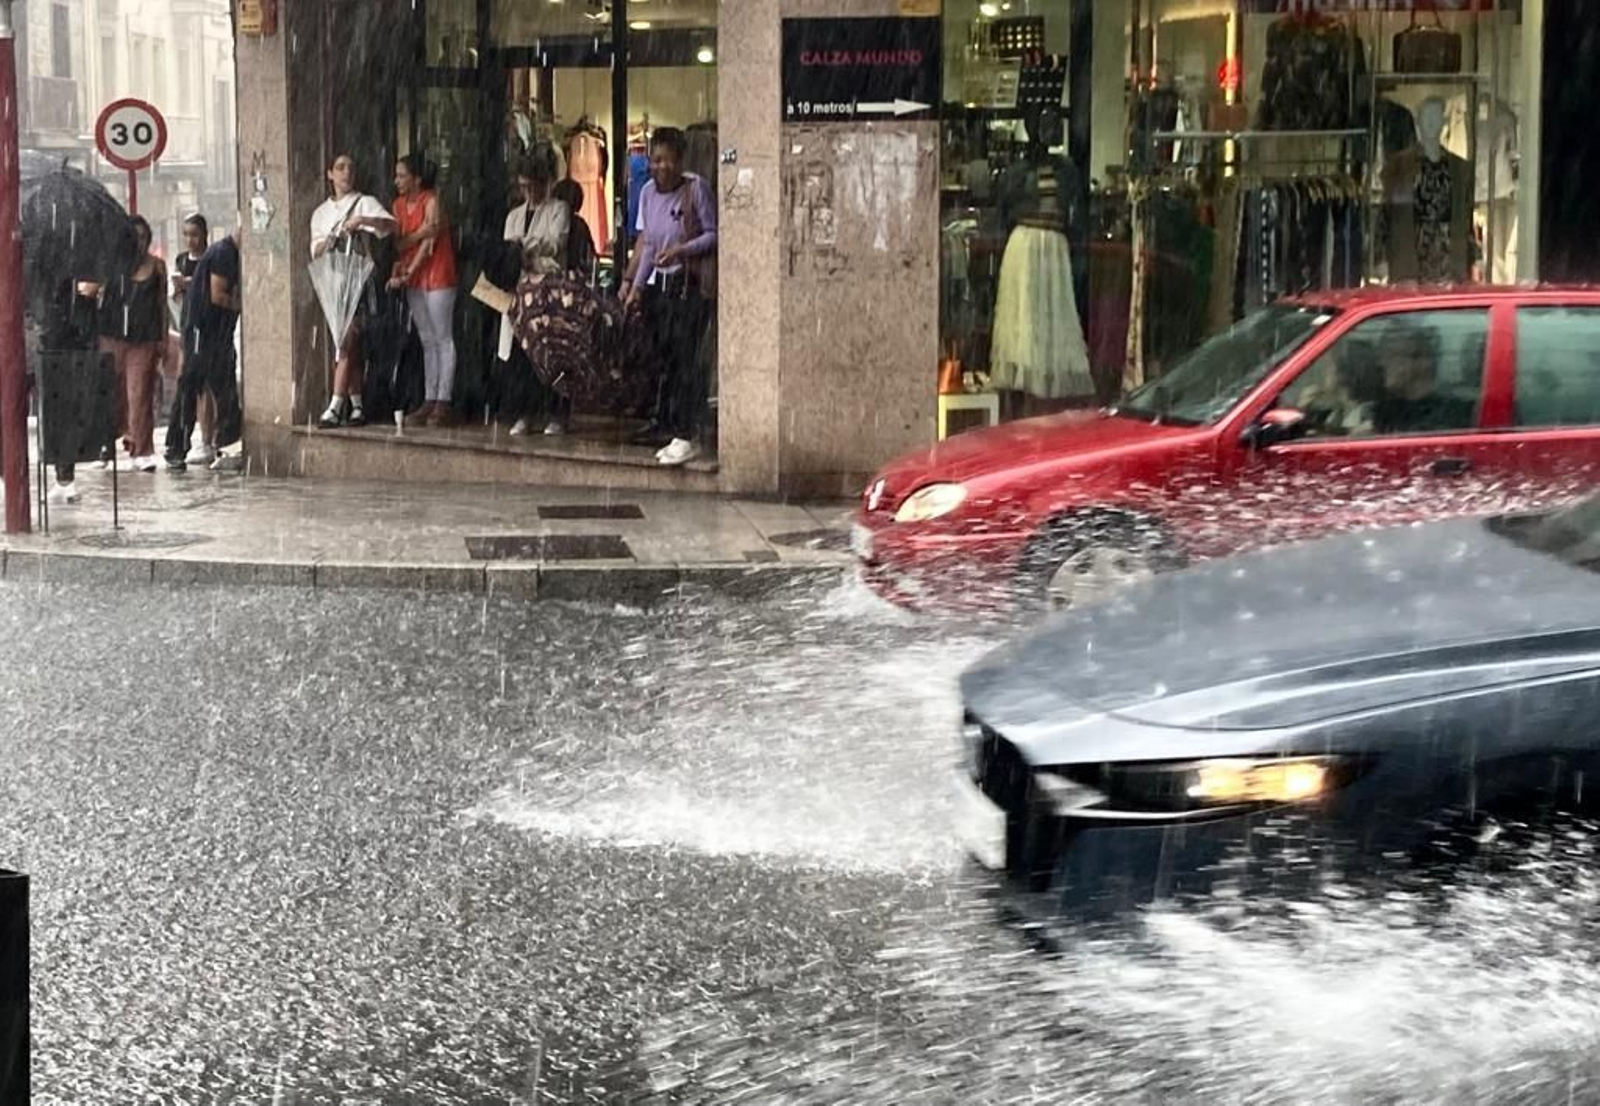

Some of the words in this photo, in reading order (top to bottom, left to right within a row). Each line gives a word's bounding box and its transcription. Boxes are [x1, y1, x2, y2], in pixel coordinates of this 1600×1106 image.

[800, 50, 851, 66] CALZA
[856, 49, 923, 65] MUNDO
[798, 101, 810, 114] 10
[813, 101, 852, 114] metros
[111, 121, 153, 146] 30
